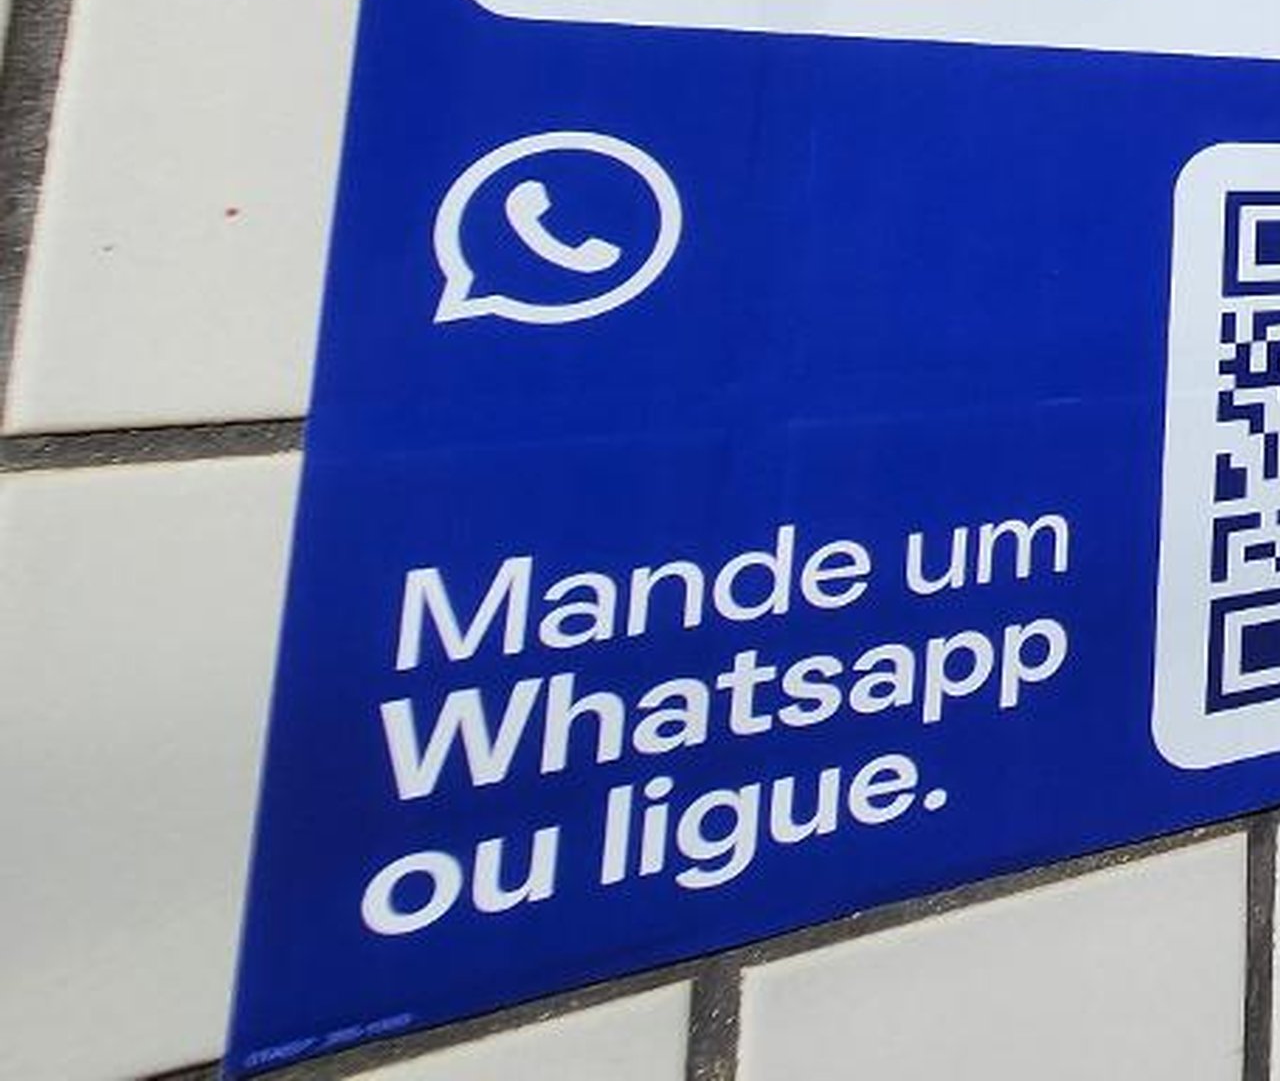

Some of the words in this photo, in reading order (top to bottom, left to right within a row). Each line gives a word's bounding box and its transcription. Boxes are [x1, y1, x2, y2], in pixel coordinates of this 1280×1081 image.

[395, 524, 872, 672] Mande
[905, 513, 1070, 596] um
[379, 617, 1070, 801] Whatsapp
[360, 825, 559, 937] ou
[600, 753, 948, 890] ligue.
